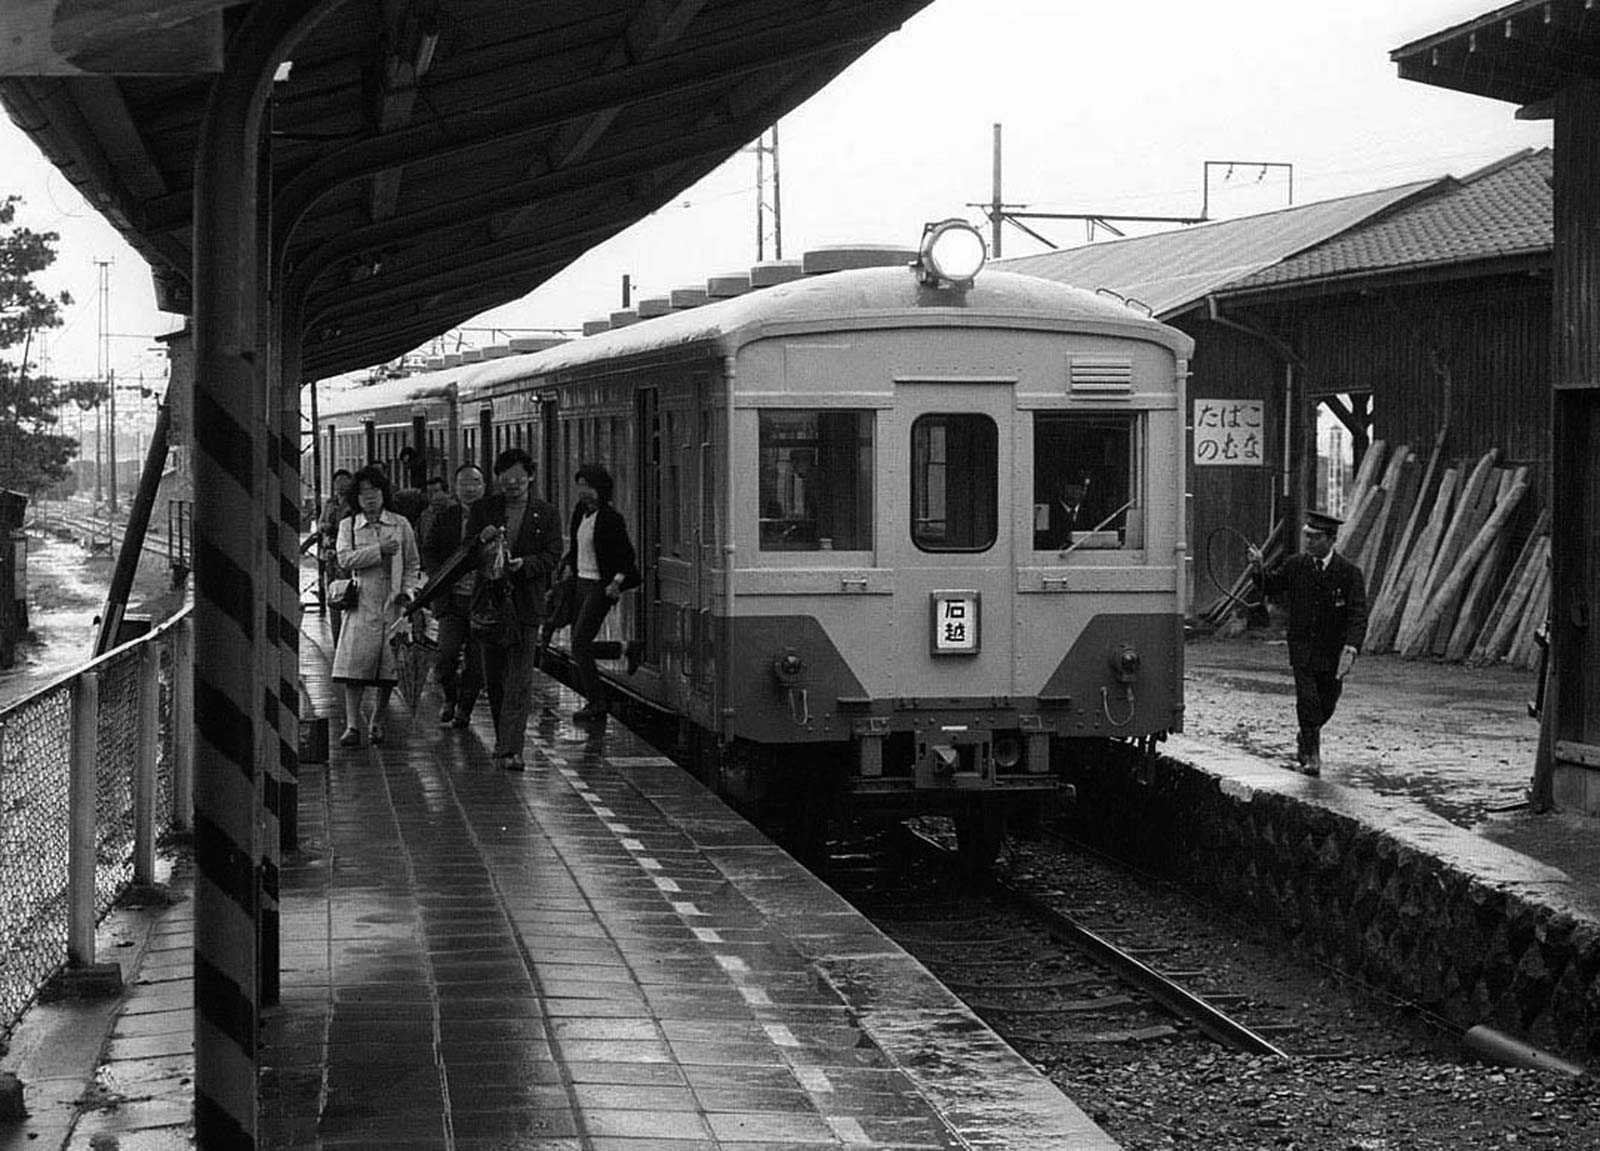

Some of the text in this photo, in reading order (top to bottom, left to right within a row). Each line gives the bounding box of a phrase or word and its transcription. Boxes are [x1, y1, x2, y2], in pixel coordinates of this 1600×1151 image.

[1198, 404, 1261, 428] たばこ
[1198, 432, 1260, 460] のむな
[945, 599, 966, 642] 石越
